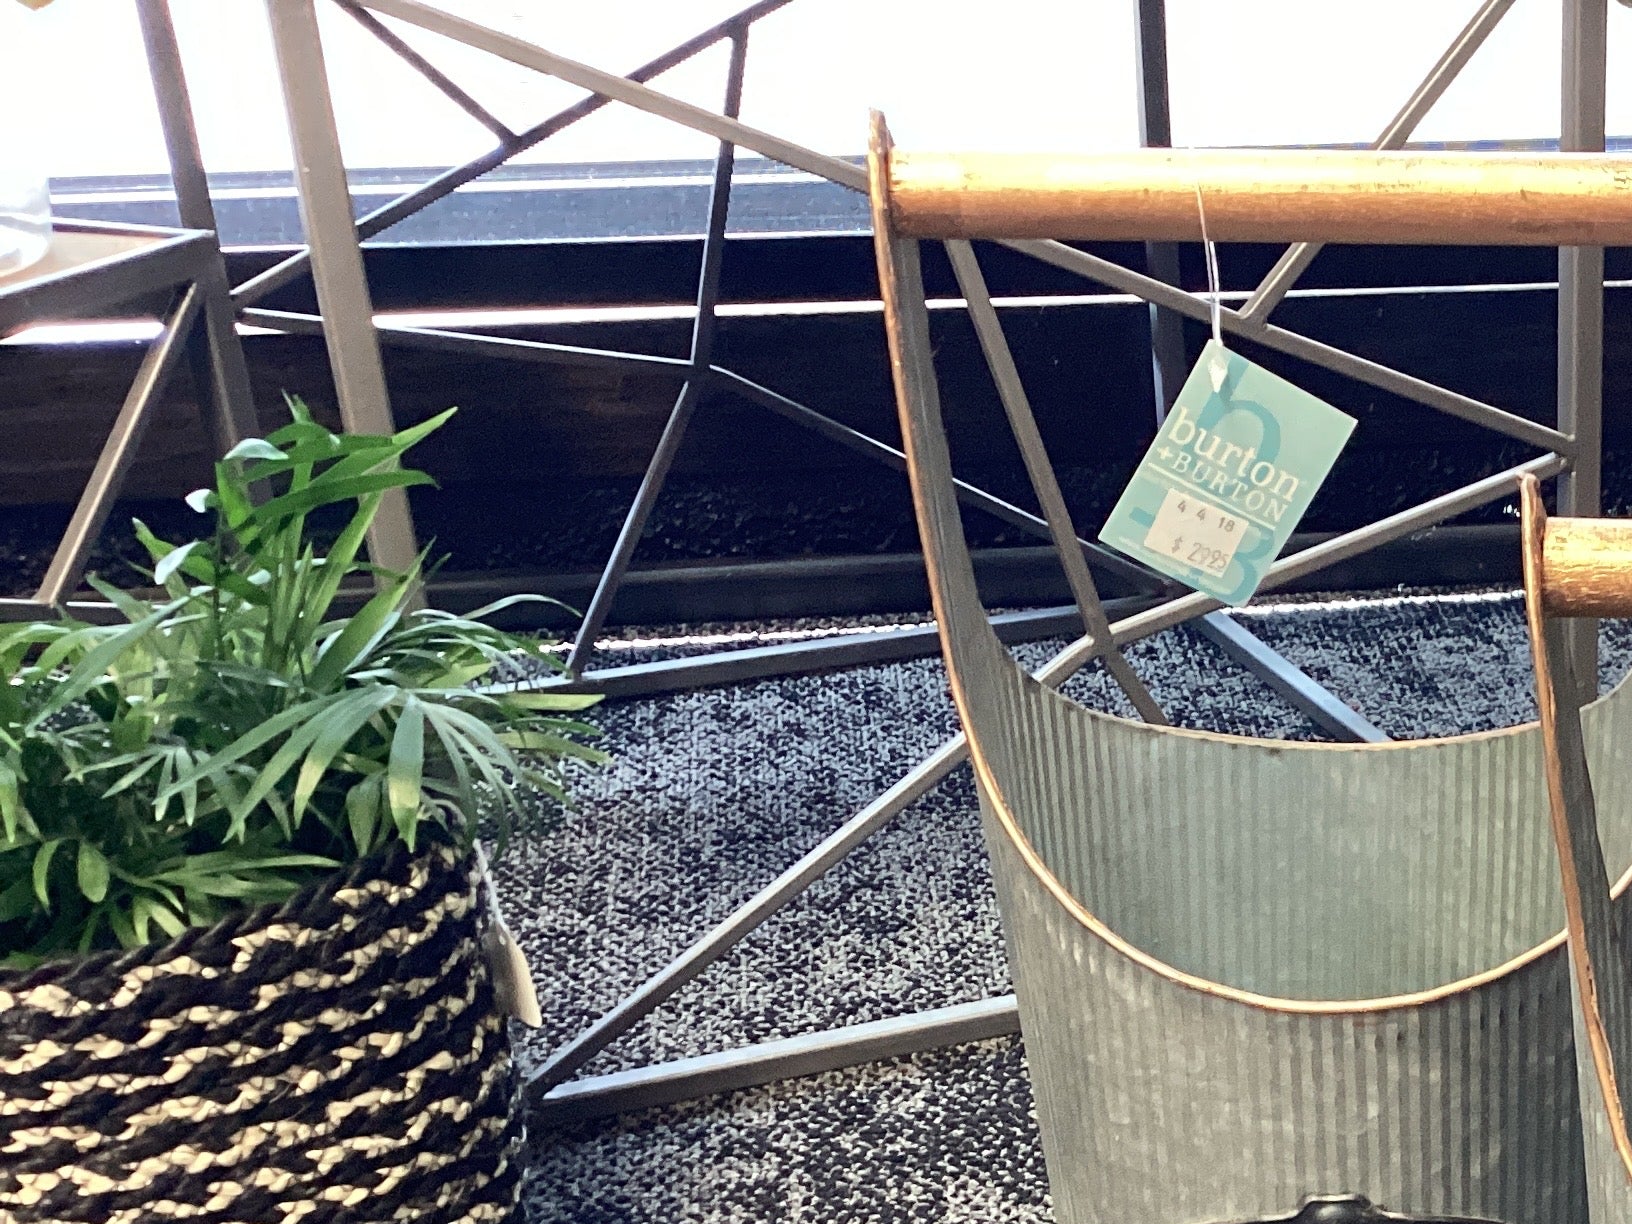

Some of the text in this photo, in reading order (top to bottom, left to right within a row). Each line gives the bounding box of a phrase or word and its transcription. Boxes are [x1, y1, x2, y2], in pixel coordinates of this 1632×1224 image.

[1168, 406, 1299, 502] burton
[1177, 500, 1187, 513] 4
[1217, 516, 1236, 532] 18
